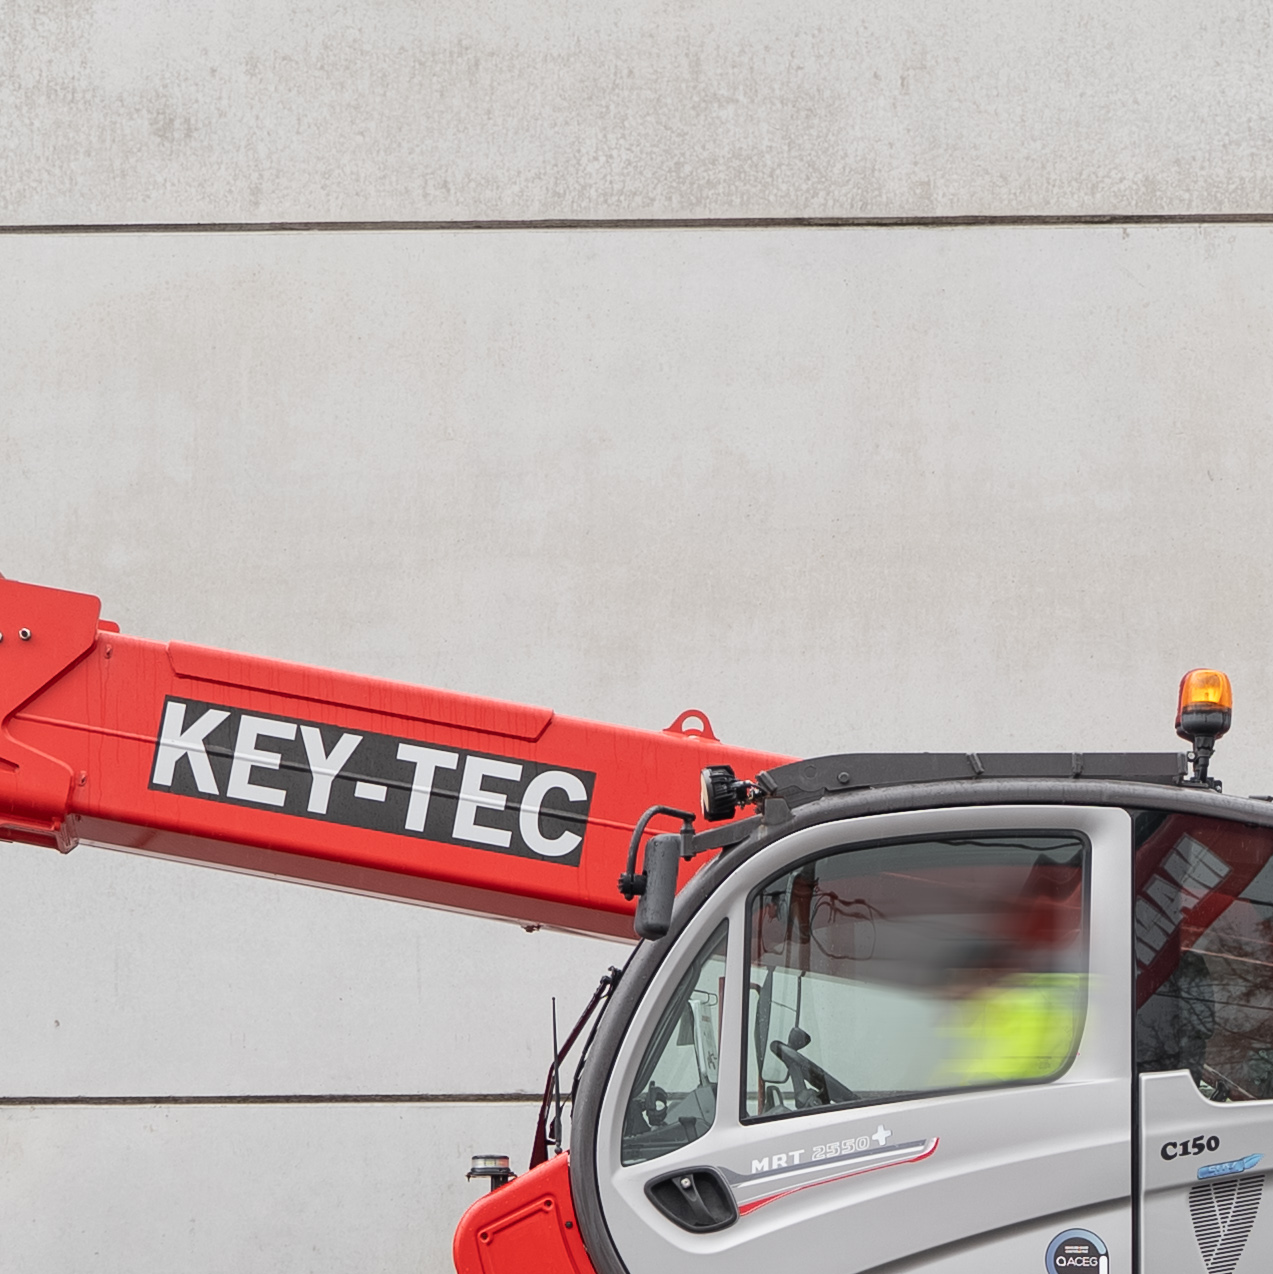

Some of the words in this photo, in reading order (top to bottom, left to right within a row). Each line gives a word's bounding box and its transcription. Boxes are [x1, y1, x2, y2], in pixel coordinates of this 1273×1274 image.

[152, 701, 588, 858] KEY-TEC
[1160, 1135, 1220, 1161] C150
[751, 1149, 805, 1174] MRT
